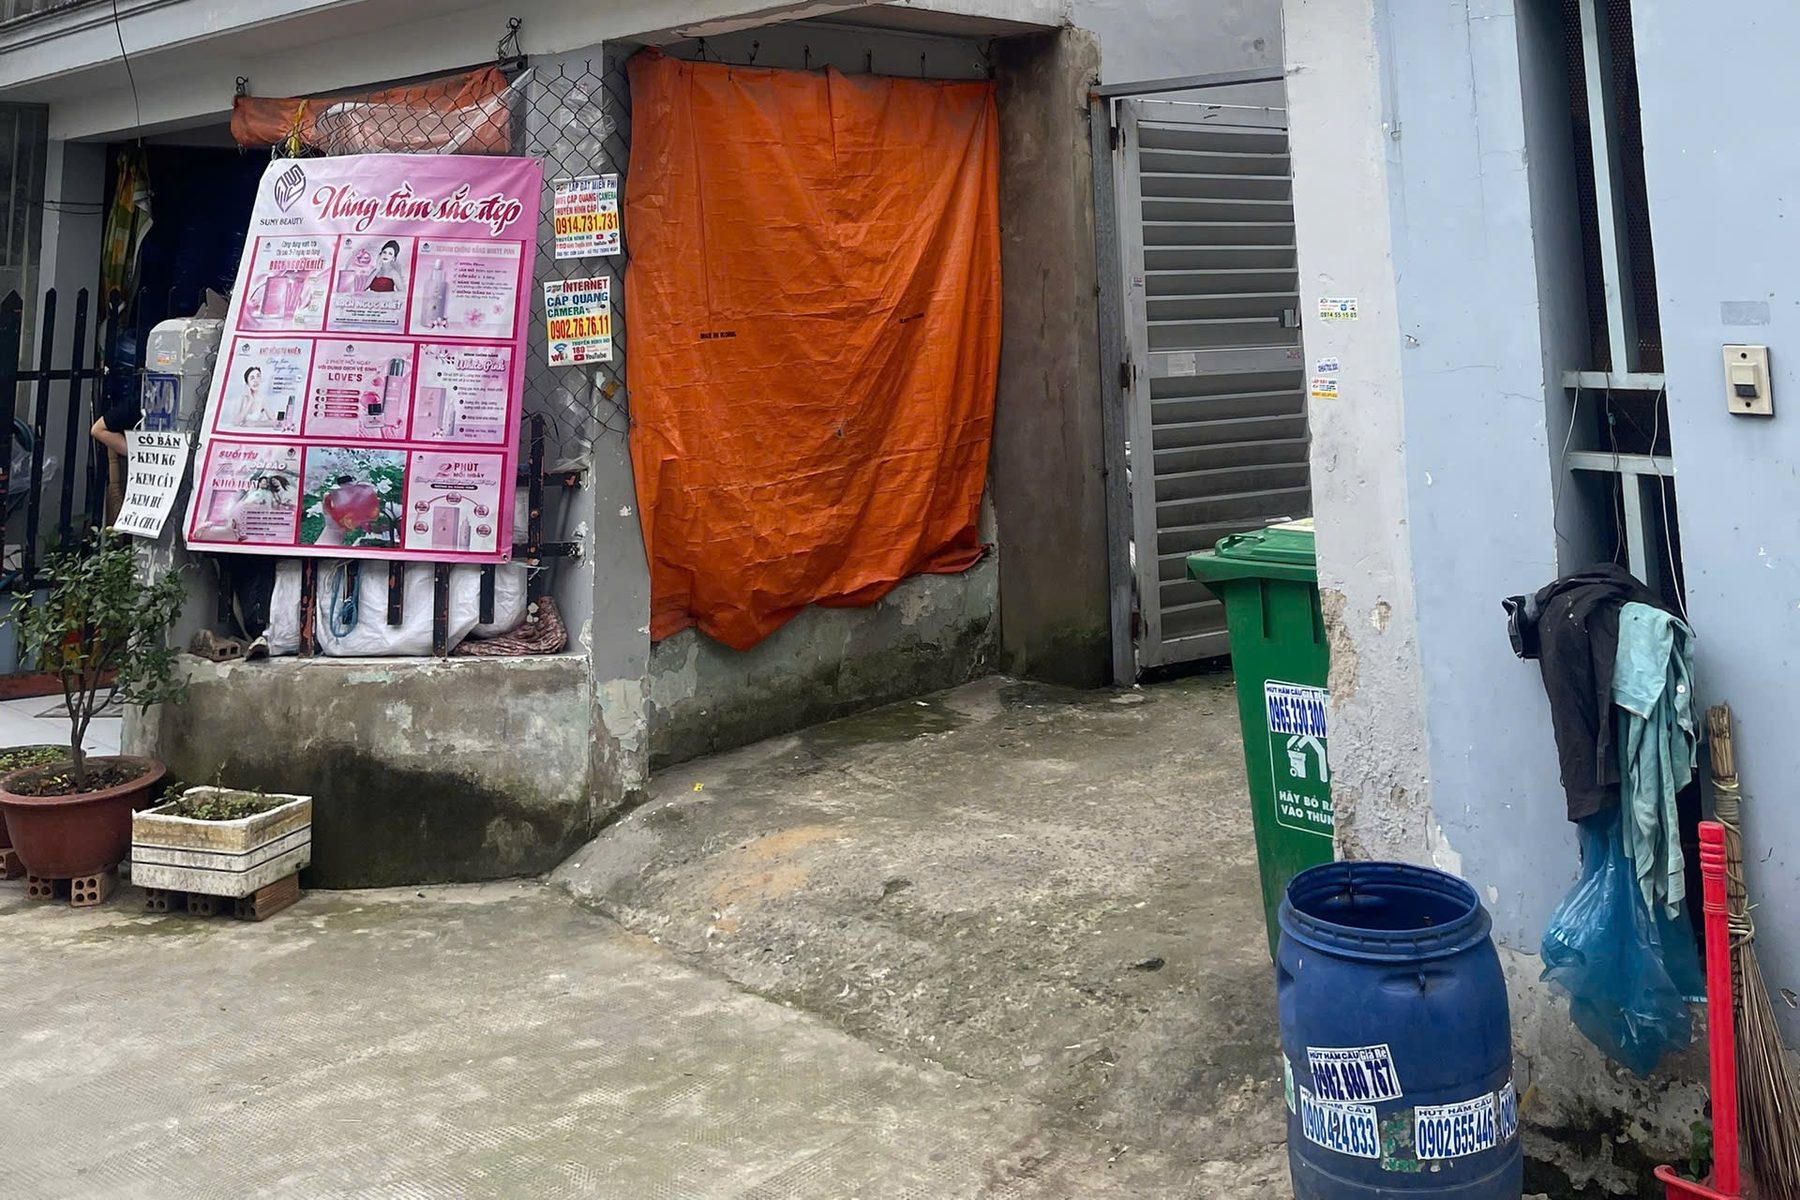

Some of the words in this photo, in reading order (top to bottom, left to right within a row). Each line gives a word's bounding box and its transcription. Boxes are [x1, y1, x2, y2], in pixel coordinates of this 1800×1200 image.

[312, 184, 379, 231] Nâng
[381, 182, 433, 219] tầm
[434, 186, 474, 221] sắc
[475, 195, 520, 233] đẹp
[279, 217, 304, 226] BEAUTY
[555, 212, 618, 235] 0914.731.731
[563, 279, 609, 293] INTERNET
[547, 294, 569, 308] CÁP
[572, 292, 608, 306] QUANG
[547, 305, 585, 318] CAMERA
[550, 315, 609, 340] 0902.76.76.11
[585, 352, 607, 360] YouTube
[328, 372, 363, 382] LOVE'S
[138, 433, 154, 445] CÓ
[157, 434, 181, 447] BÁN
[137, 451, 159, 465] KEM
[161, 453, 176, 467] KG
[454, 461, 479, 472] PHÚT
[135, 472, 156, 486] KEM
[130, 493, 150, 507] KEM
[1279, 790, 1300, 804] HÃY
[1303, 794, 1319, 808] BỎ
[1281, 803, 1303, 819] VÀO
[1302, 1099, 1376, 1155] 0908.424.833
[1419, 1107, 1494, 1157] 0902.655.446
